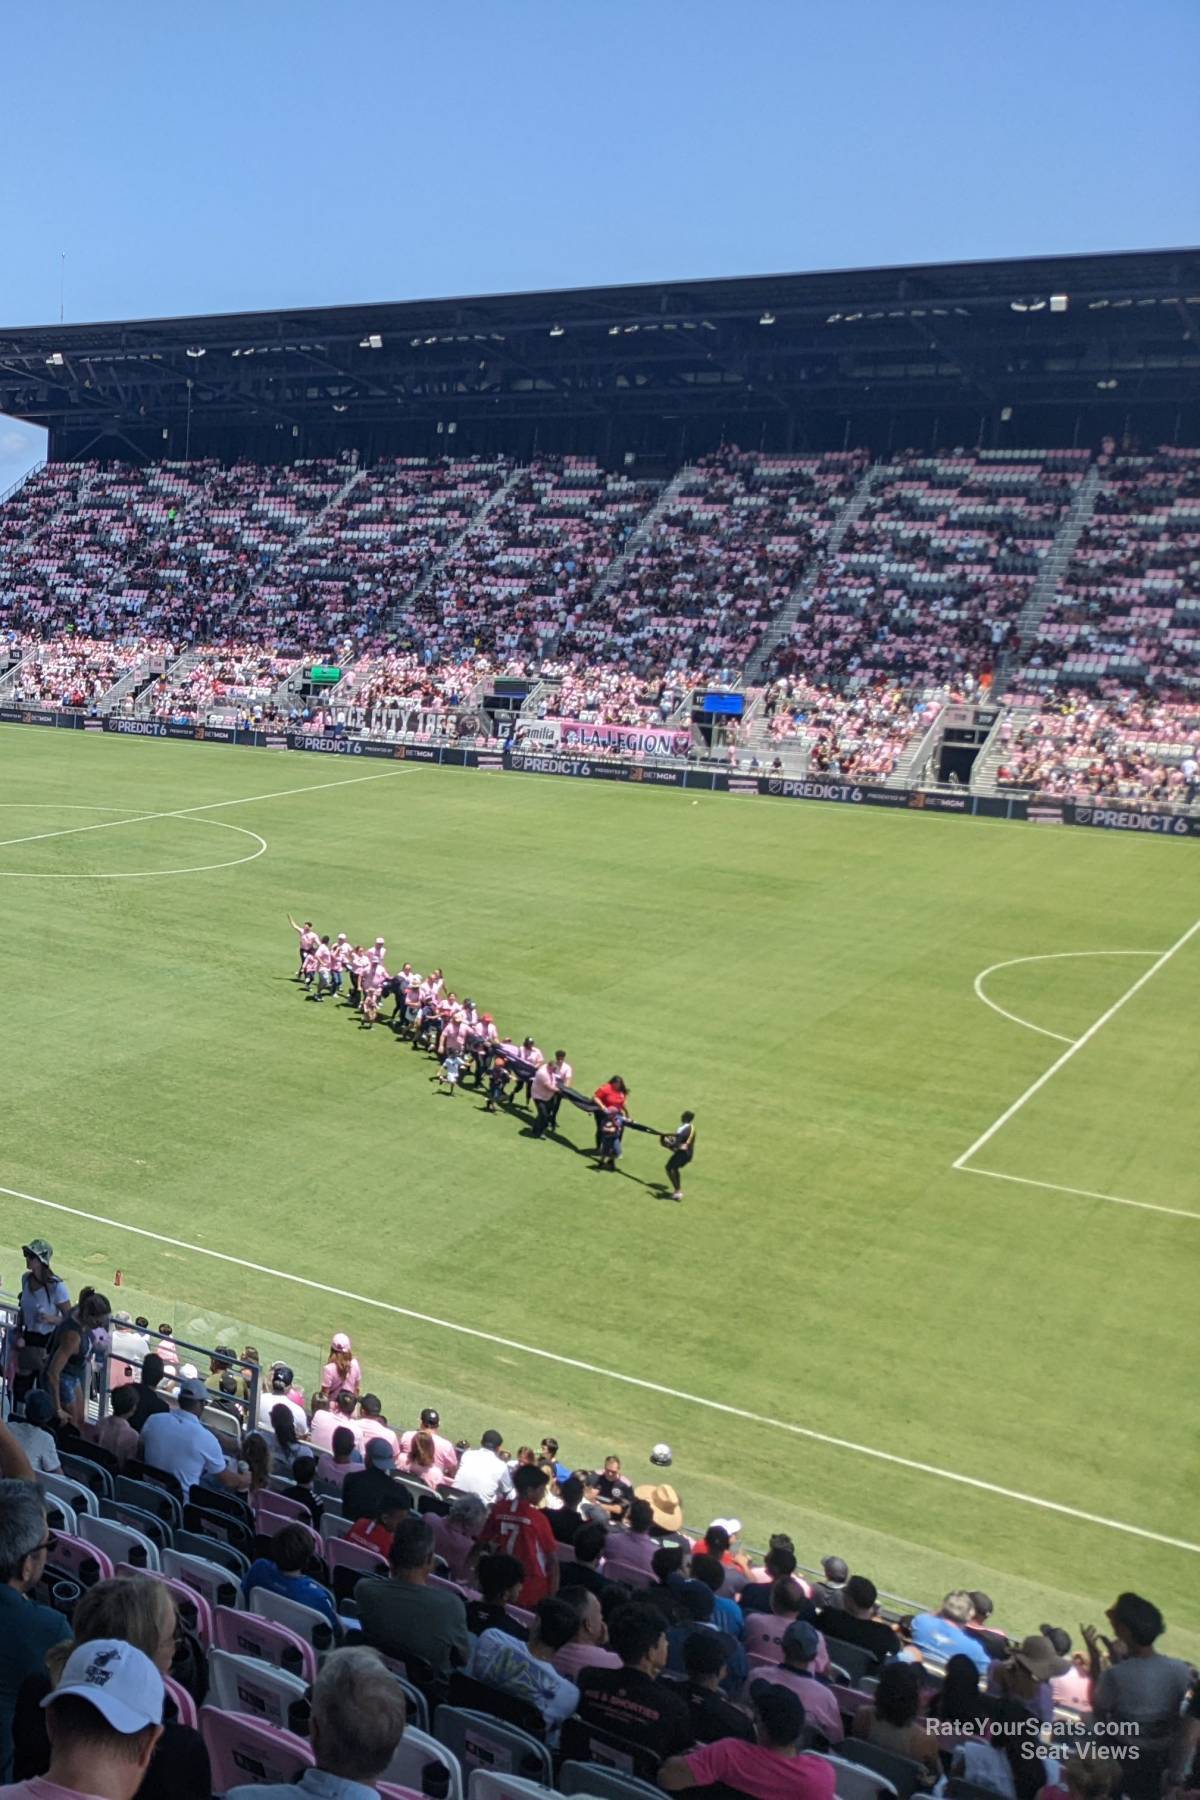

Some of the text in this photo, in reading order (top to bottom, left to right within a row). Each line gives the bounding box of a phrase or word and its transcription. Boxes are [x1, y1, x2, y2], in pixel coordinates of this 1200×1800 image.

[118, 720, 158, 736] PREDICT
[159, 725, 167, 736] 6
[371, 708, 412, 733] CITY
[304, 737, 351, 753] PREDICT
[353, 742, 362, 754] 6
[406, 750, 434, 758] BETMGM
[581, 728, 671, 754] LA LEGION
[523, 758, 580, 775] PREDICT
[580, 762, 590, 776] 6
[643, 770, 677, 781] BETMGM
[783, 781, 850, 799] PREDICT
[851, 787, 863, 801] 6
[926, 798, 965, 809] BETMGM
[1091, 809, 1174, 832] PREDICT
[1174, 818, 1188, 833] 6
[500, 1521, 520, 1555] 7
